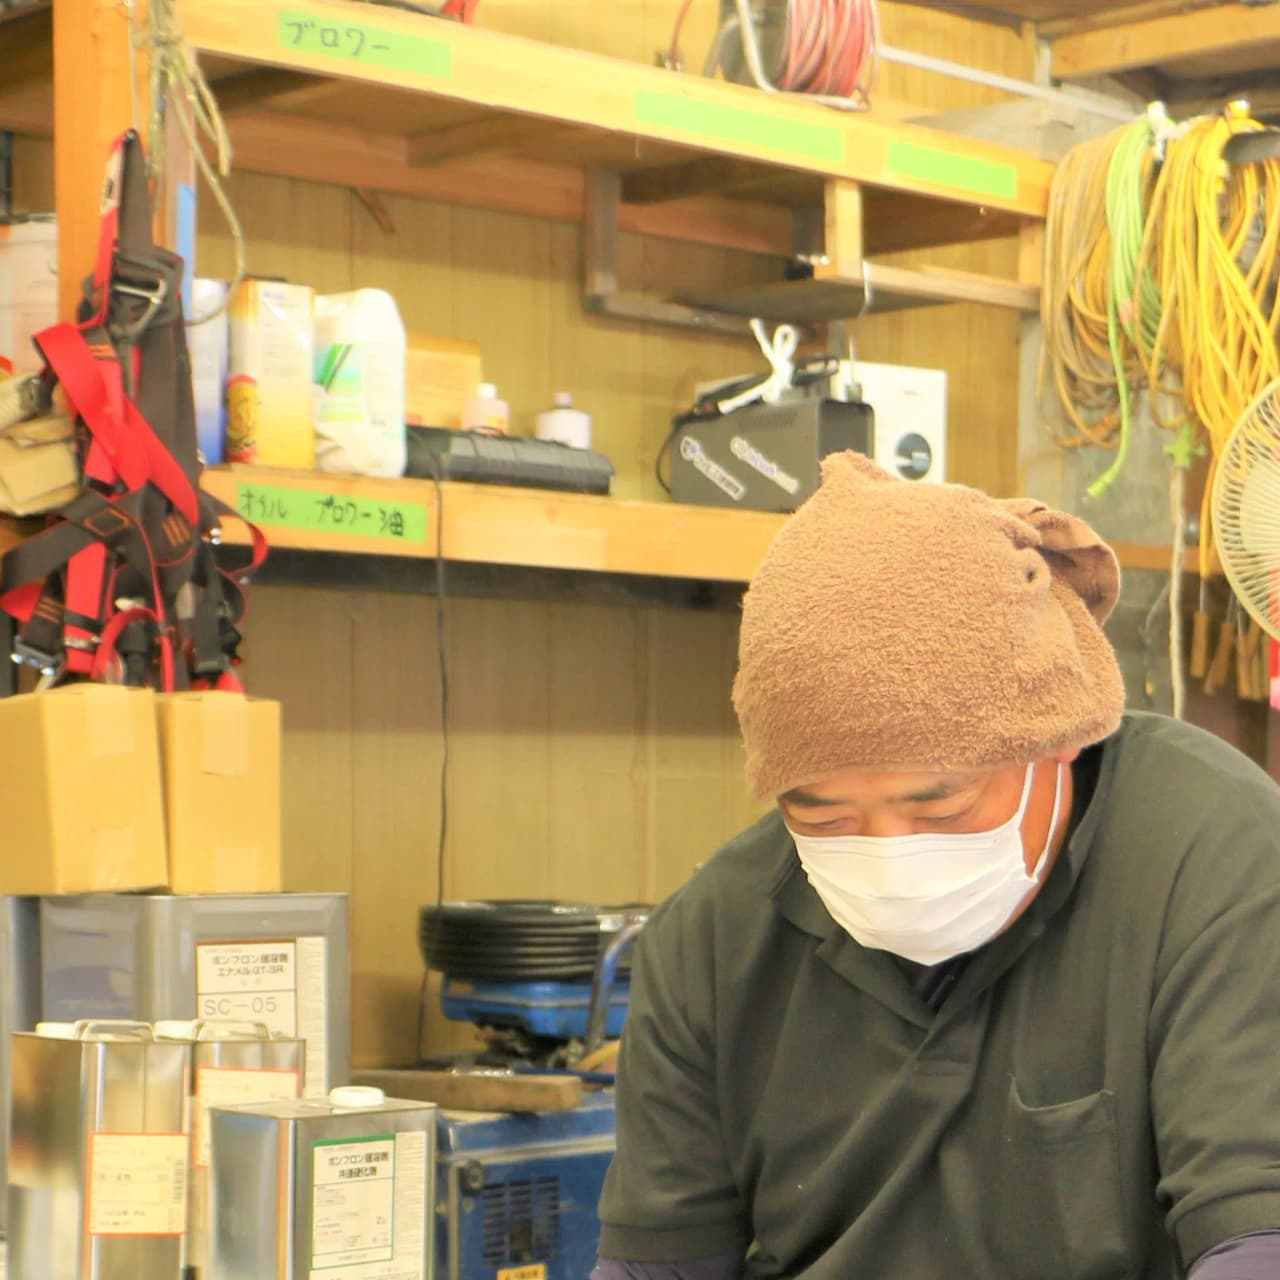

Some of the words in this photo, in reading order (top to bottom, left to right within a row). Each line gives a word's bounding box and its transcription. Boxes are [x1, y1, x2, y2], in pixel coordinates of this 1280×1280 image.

[286, 20, 391, 57] ブロワー
[240, 489, 289, 519] オイル
[202, 996, 277, 1017] SC-05
